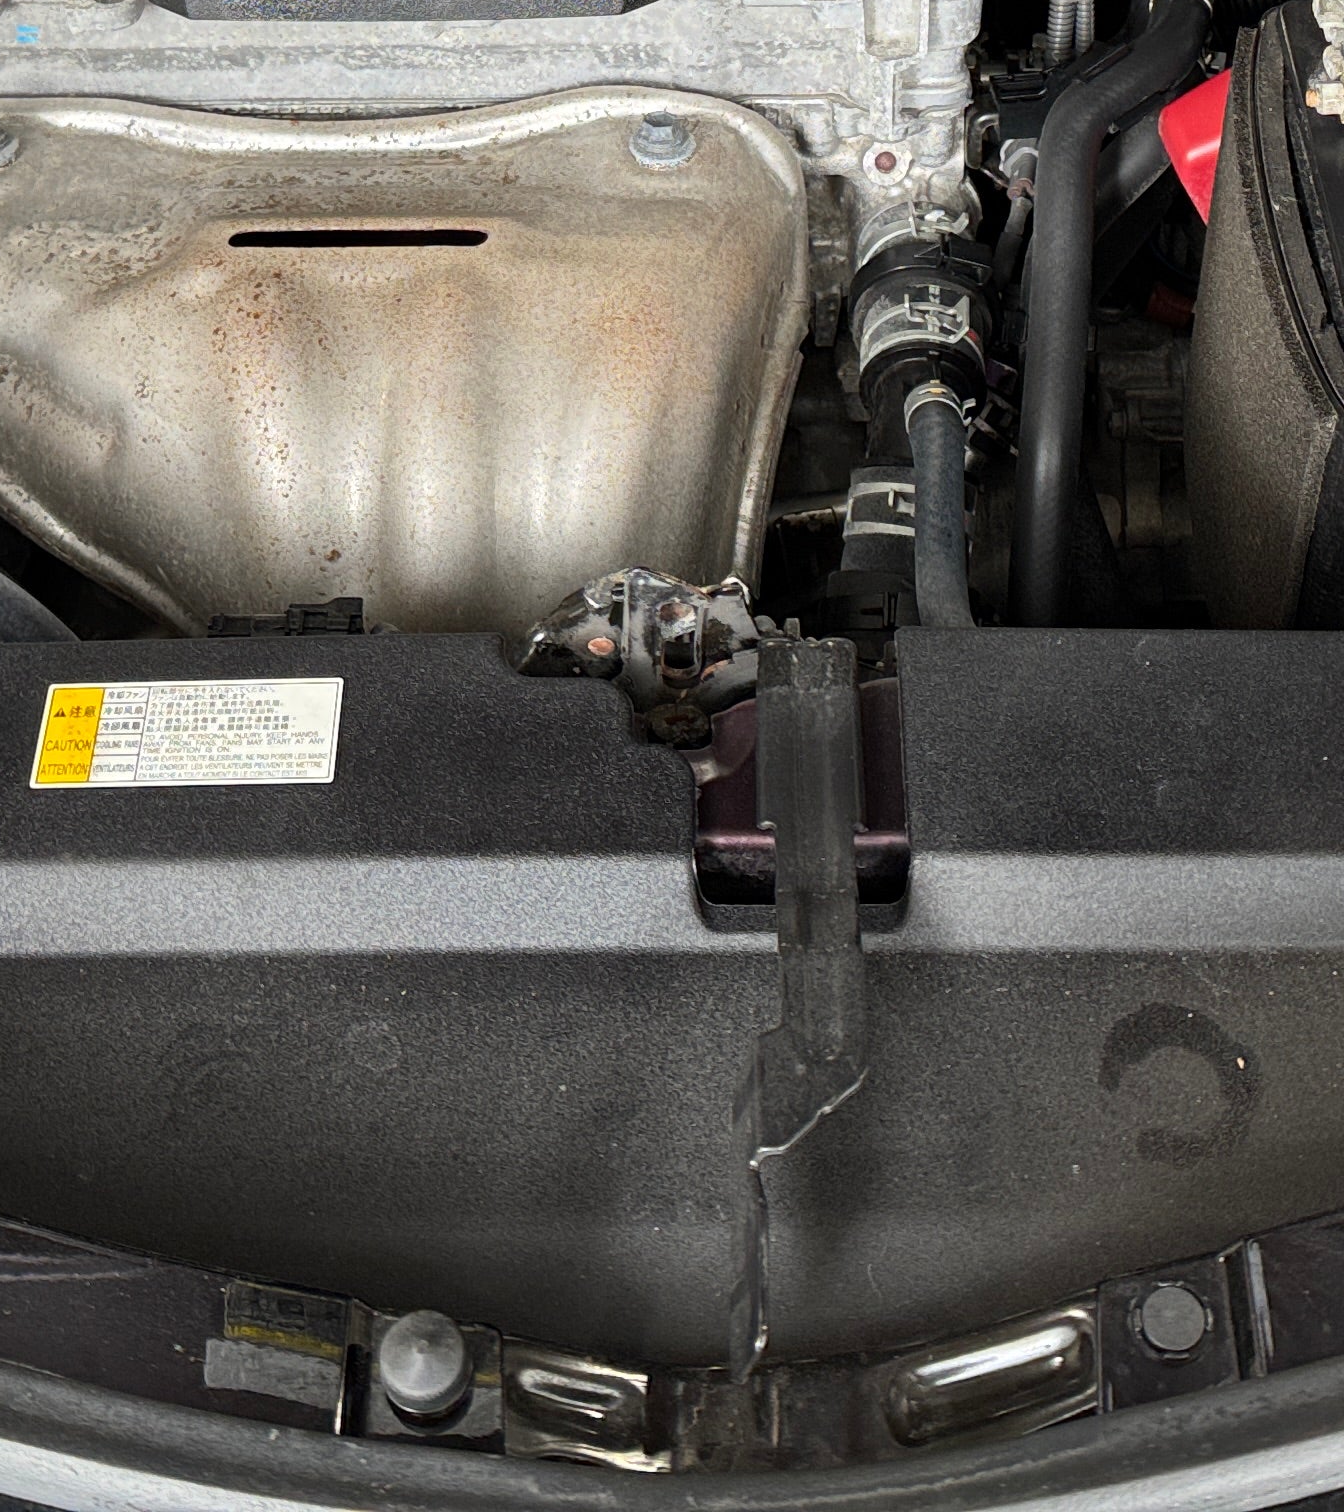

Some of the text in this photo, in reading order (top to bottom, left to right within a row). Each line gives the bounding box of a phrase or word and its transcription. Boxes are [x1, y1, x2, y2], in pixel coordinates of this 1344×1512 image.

[69, 705, 96, 718] 注意
[46, 740, 93, 752] CAUTION
[247, 738, 263, 746] MAY
[40, 762, 90, 776] ATTENTION
